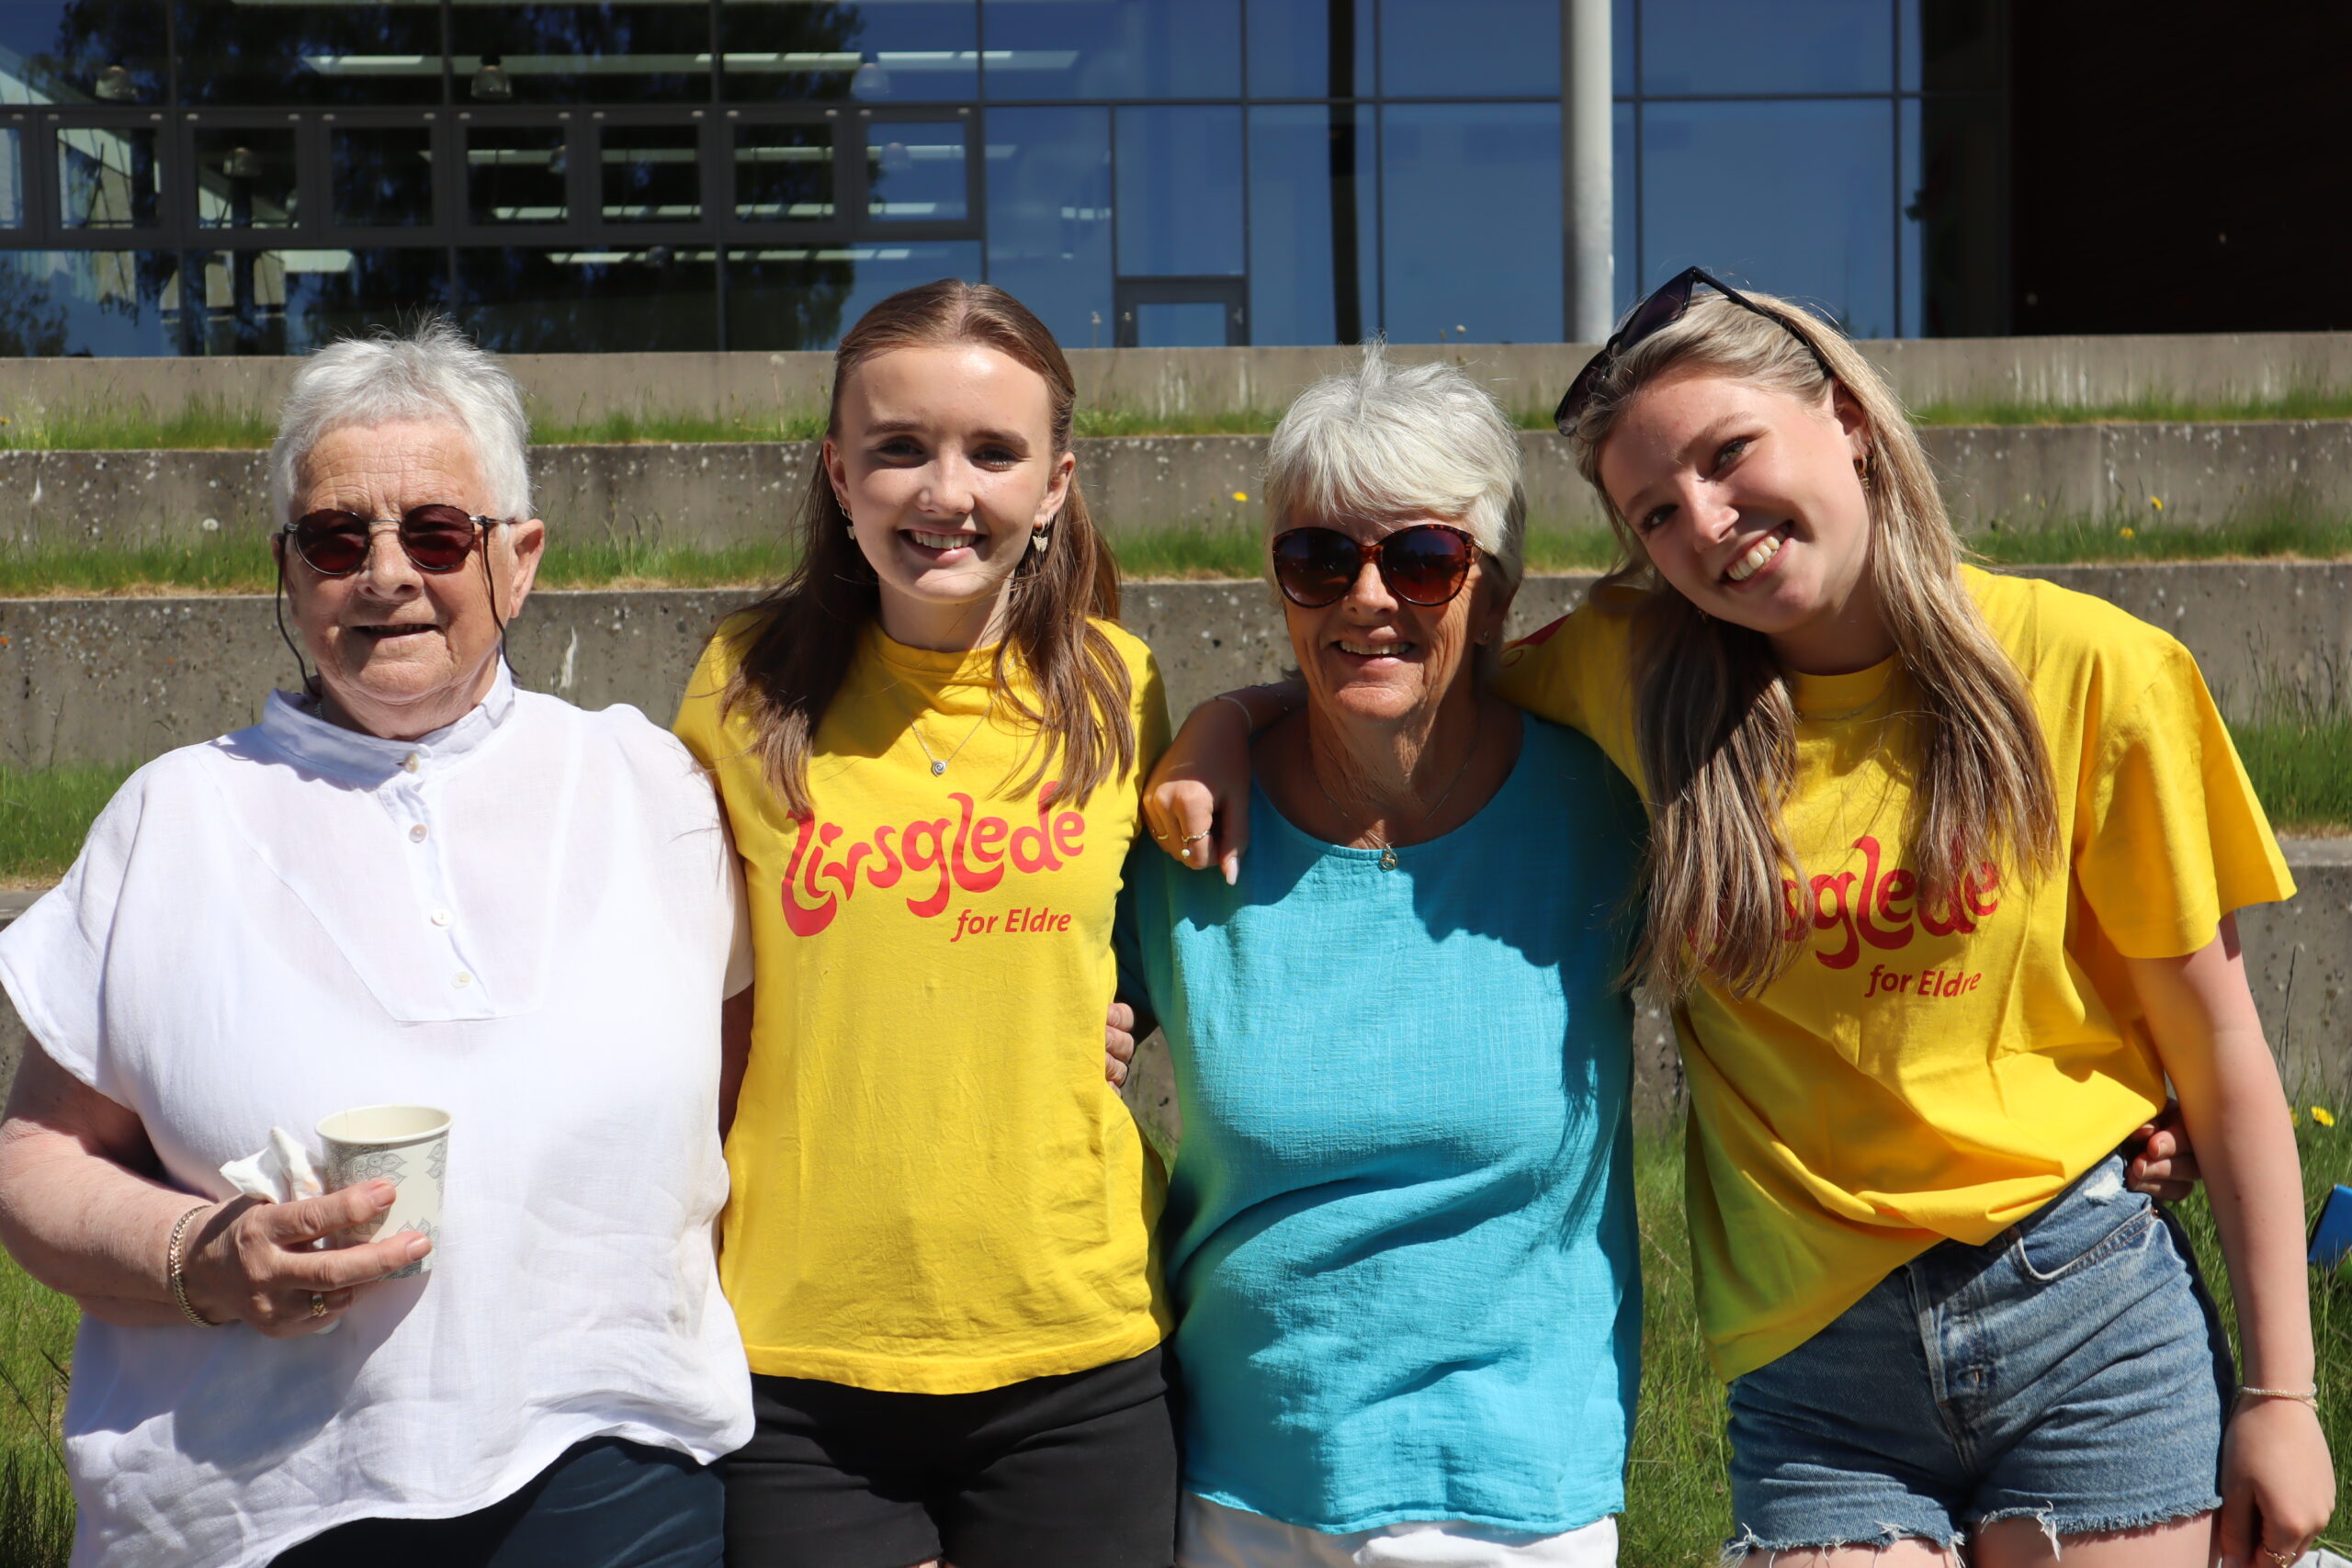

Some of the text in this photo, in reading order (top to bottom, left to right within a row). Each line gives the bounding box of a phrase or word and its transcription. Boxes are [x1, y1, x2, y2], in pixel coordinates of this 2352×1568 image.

[950, 908, 1071, 942] for Eldre
[1865, 964, 1982, 998] for Eldre
